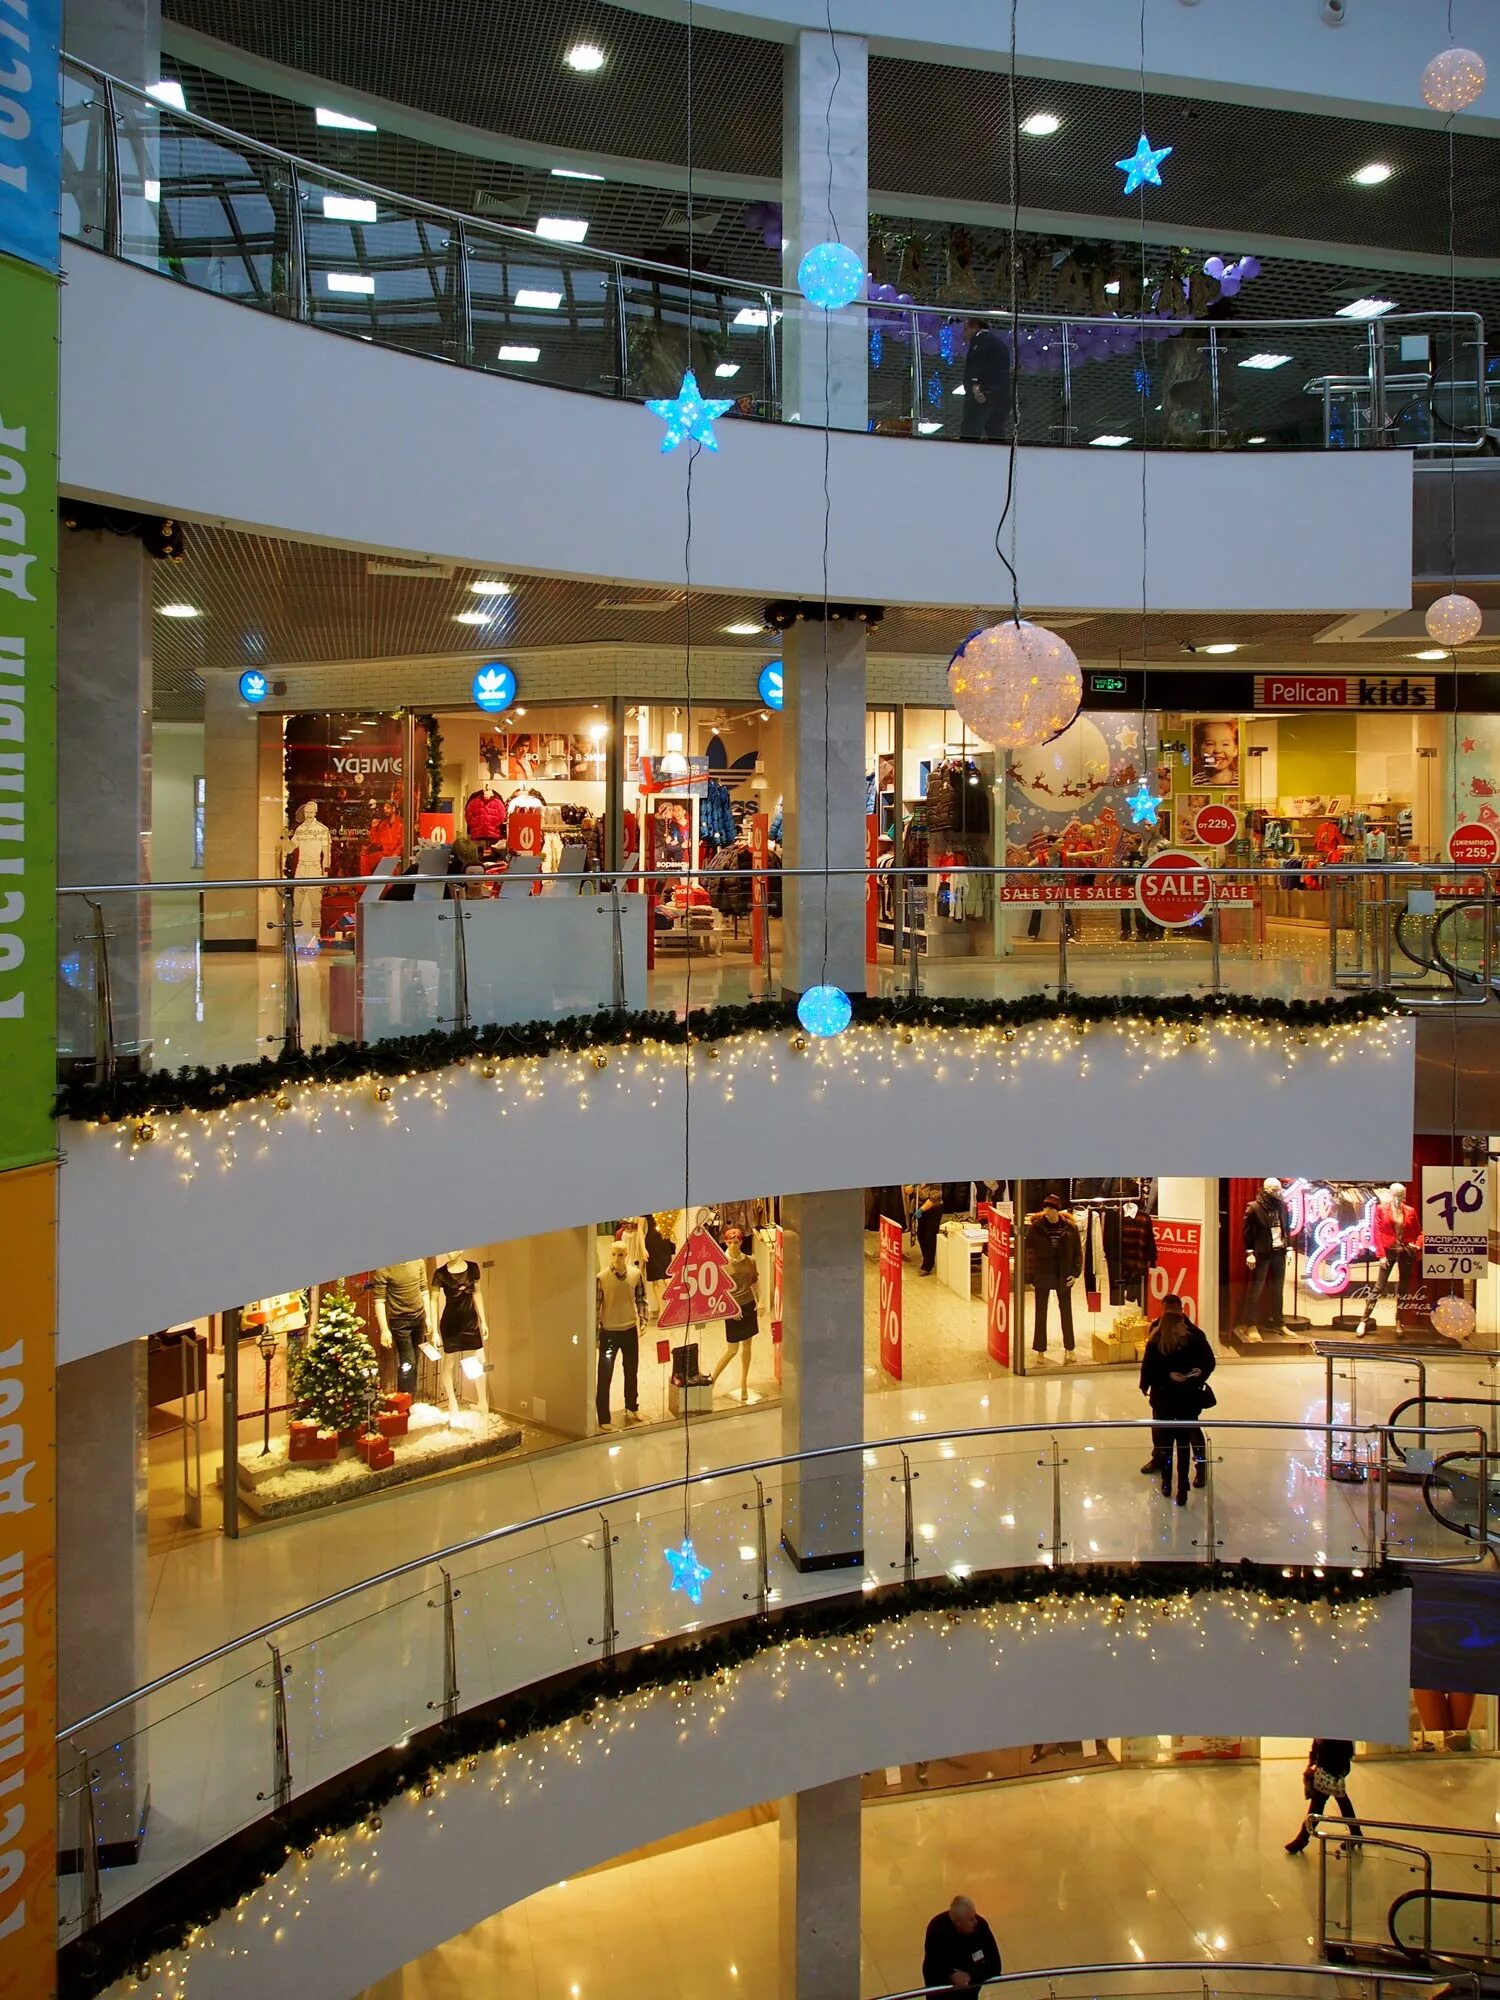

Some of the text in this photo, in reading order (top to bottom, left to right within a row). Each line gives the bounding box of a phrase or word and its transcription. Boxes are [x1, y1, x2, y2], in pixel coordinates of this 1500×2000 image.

[1271, 678, 1428, 707] Pelican kids
[1003, 888, 1040, 900] SALE
[1045, 887, 1081, 900] SALE
[1087, 887, 1122, 899] SALE
[1146, 875, 1206, 897] SALE
[1152, 1226, 1198, 1244] SALE
[1424, 1236, 1487, 1245] РАСПРОДАЖА
[1436, 1247, 1475, 1255] СКИДКИ
